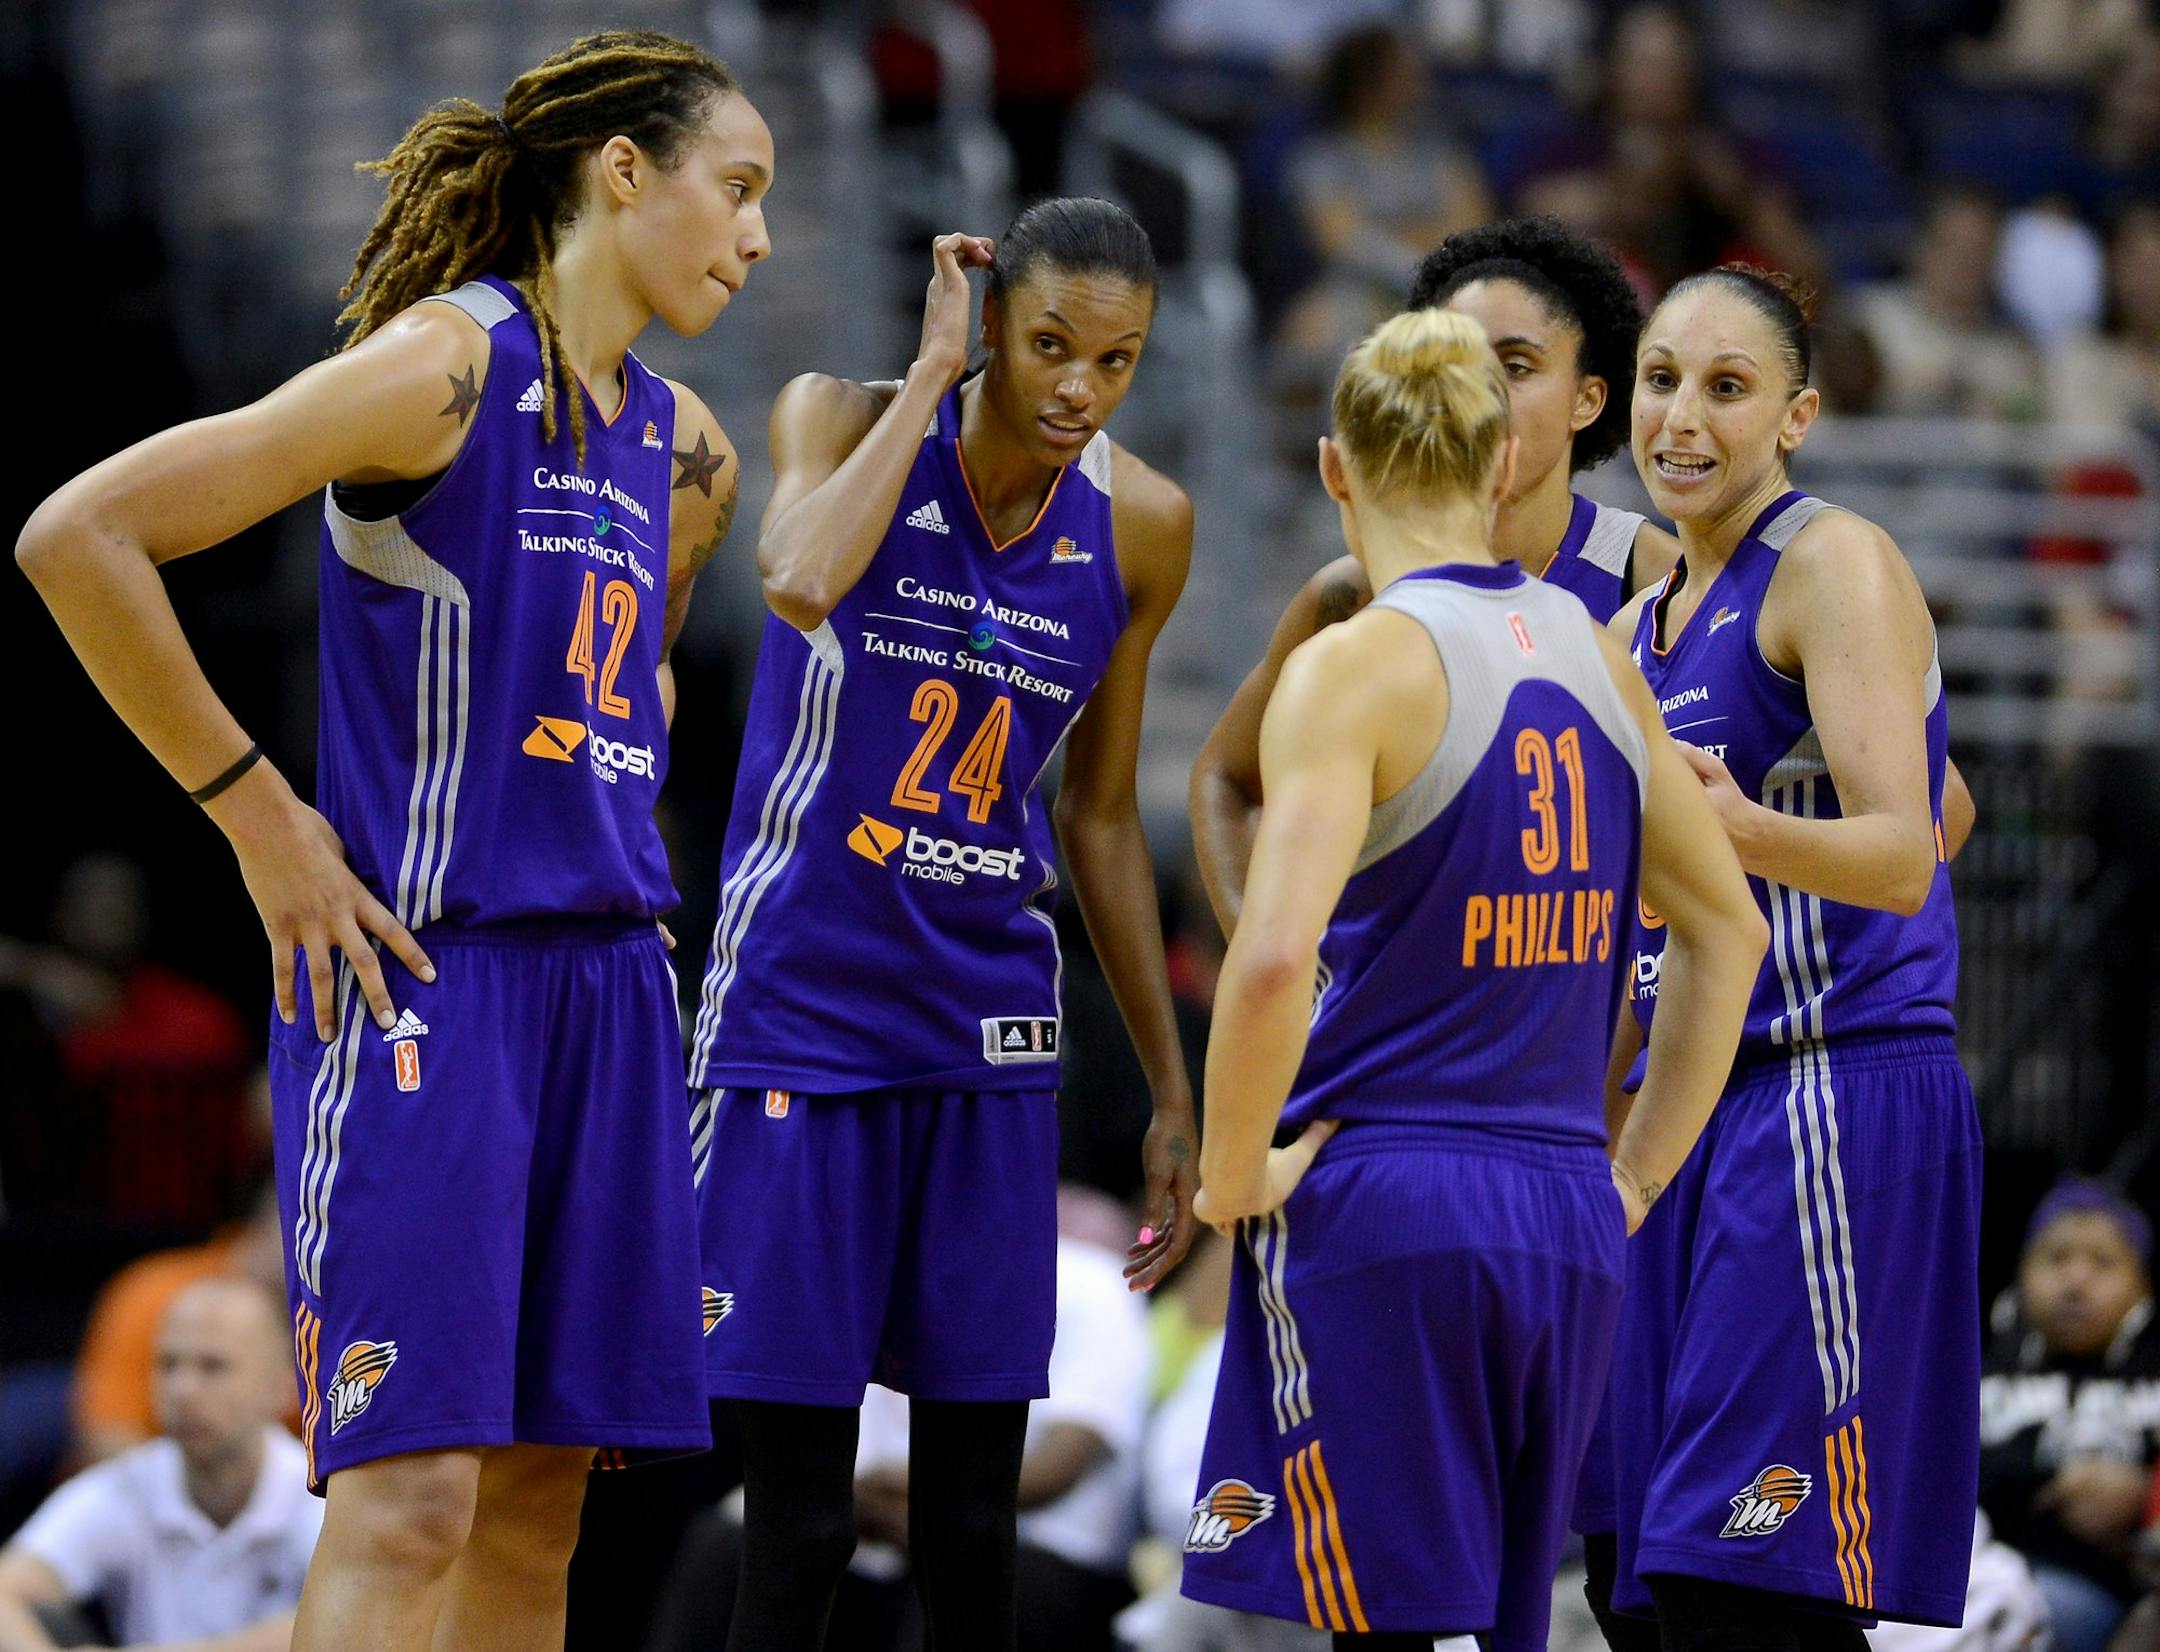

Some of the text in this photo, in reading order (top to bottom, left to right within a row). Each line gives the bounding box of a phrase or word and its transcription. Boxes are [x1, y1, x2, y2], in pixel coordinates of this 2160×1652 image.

[516, 399, 546, 412] adid
[533, 467, 650, 525] CASINO ARIZONA
[905, 516, 950, 534] adidas
[518, 529, 587, 553] TALKING
[587, 536, 626, 567] STICK
[895, 577, 1070, 640] CASINO ARIZONA
[566, 569, 638, 720] 42
[861, 632, 1075, 703] TALKING STICK RESORT
[1657, 685, 1709, 715] RIZONA
[587, 720, 655, 781] boost
[890, 678, 1013, 825] 24
[1514, 726, 1591, 876] 31
[901, 861, 966, 886] mobile
[905, 827, 1026, 881] boost
[1461, 889, 1614, 969] PHILLIPS
[383, 1023, 430, 1043] adidas
